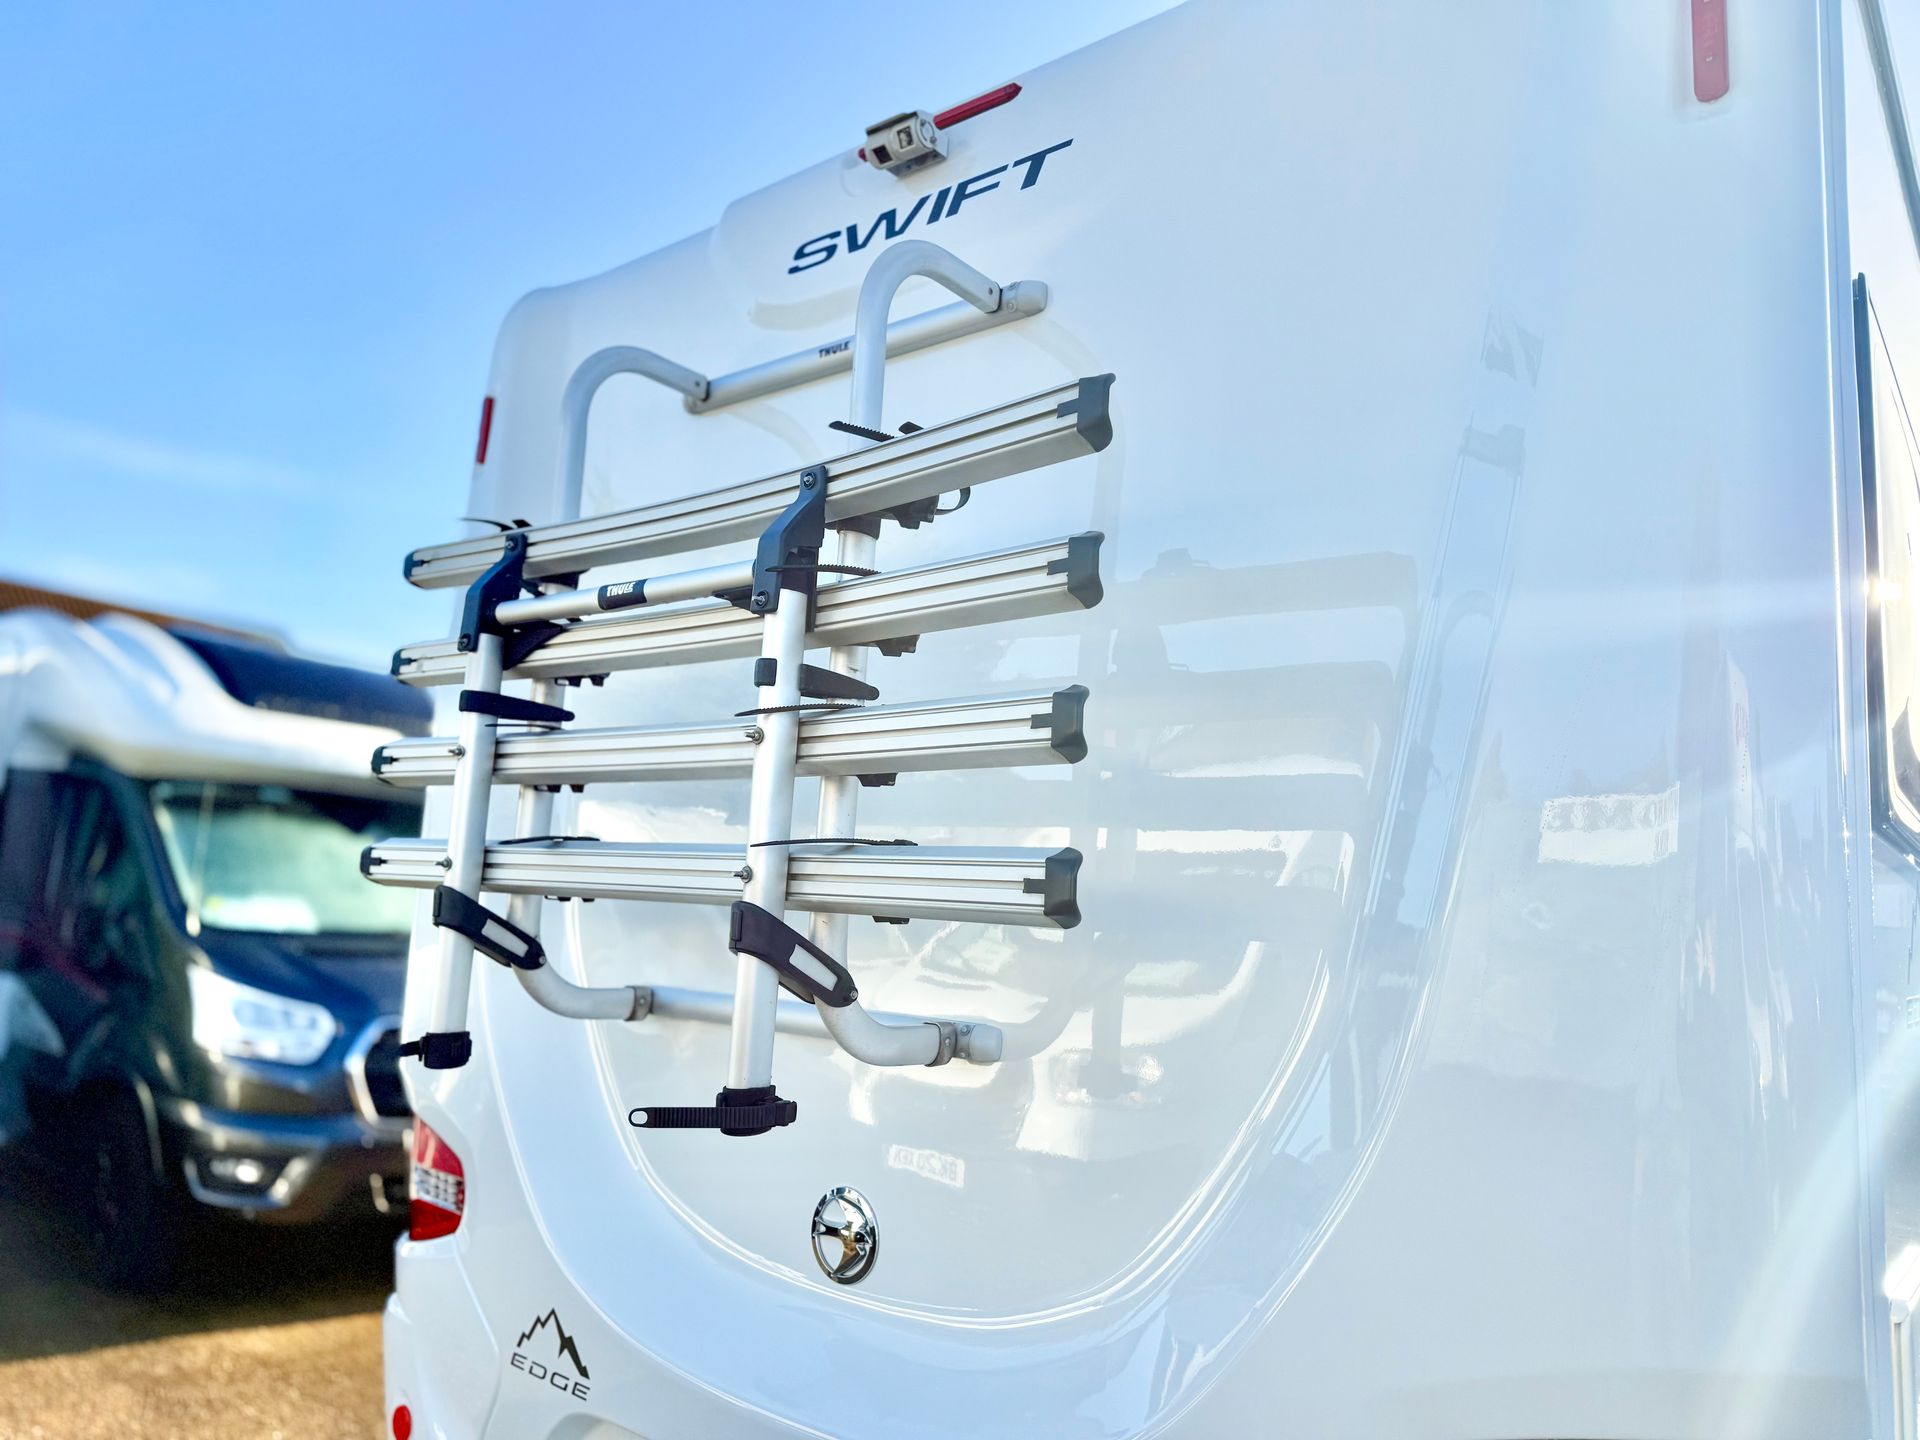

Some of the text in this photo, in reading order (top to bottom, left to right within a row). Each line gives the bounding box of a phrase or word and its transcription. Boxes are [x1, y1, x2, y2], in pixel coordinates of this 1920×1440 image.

[788, 138, 1074, 274] SWIFT
[819, 340, 851, 358] THULE
[606, 581, 636, 597] THULE
[510, 1352, 590, 1402] EDGE
